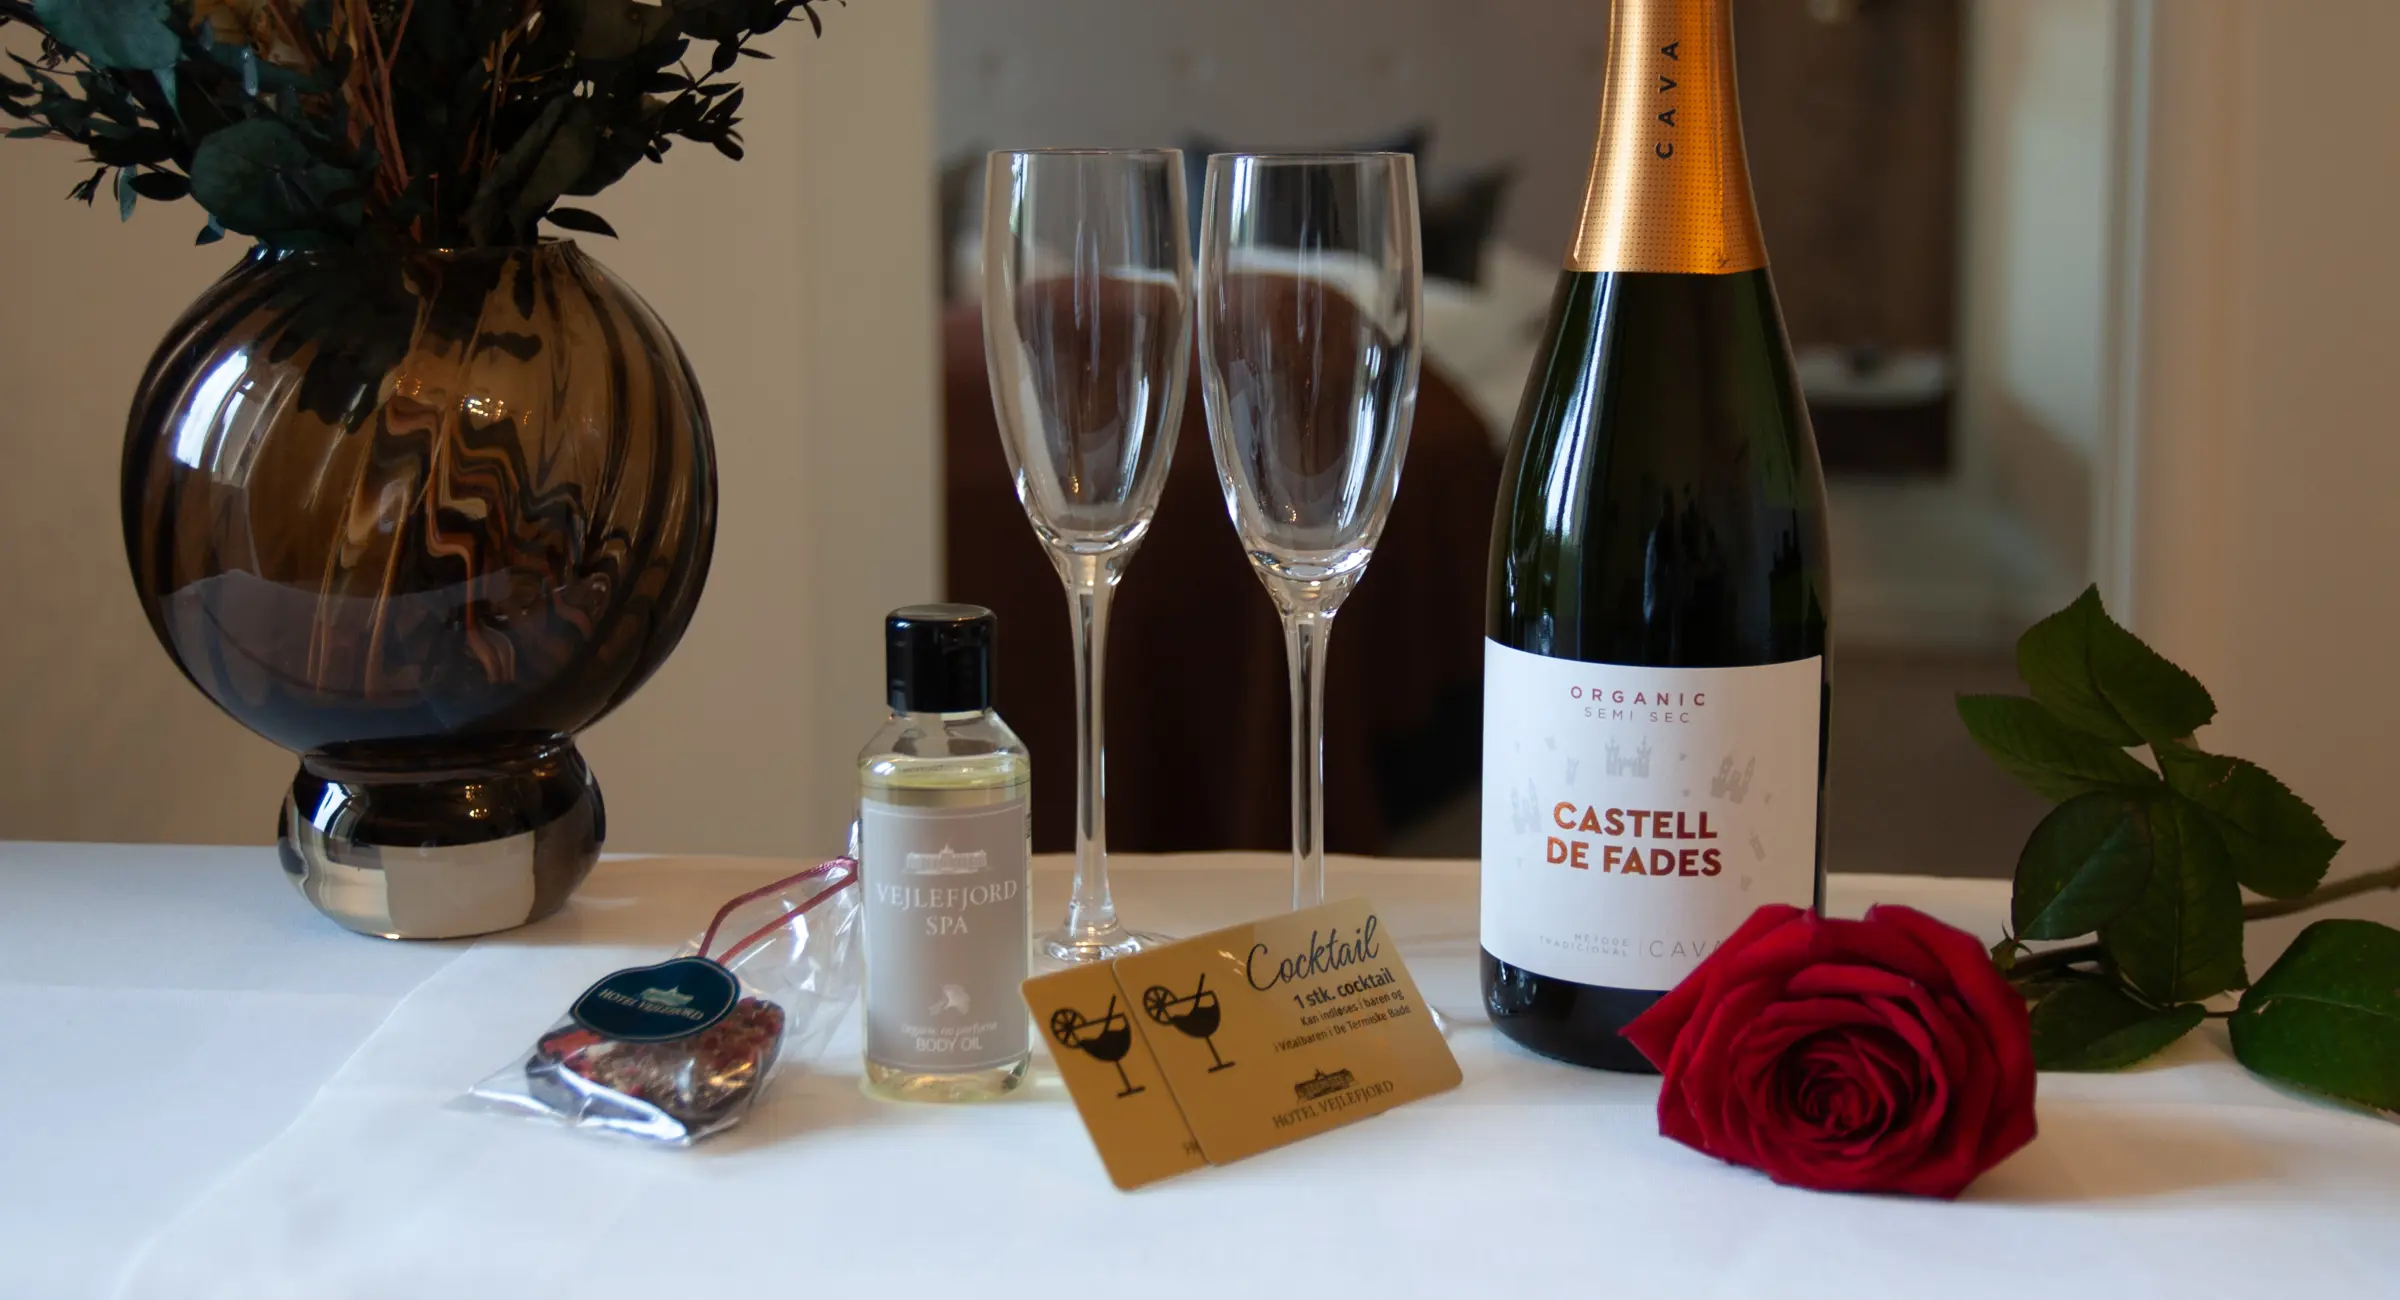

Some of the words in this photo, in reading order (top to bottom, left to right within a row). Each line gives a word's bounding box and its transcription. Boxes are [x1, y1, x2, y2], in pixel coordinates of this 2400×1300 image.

[1656, 41, 1679, 160] CAVA
[1570, 685, 1706, 706] ORGANIC
[1584, 706, 1634, 722] SEMI
[1650, 711, 1690, 723] SEC
[1553, 801, 1718, 840] CASTELL
[1546, 836, 1589, 870] DE
[1603, 845, 1722, 877] FADES
[876, 879, 1018, 911] VEJLEFJORD
[925, 916, 968, 936] SPA
[1246, 914, 1380, 992] Cocktail
[1293, 994, 1305, 1009] 1
[1305, 986, 1336, 1008] stk.
[1336, 967, 1396, 998] cocktail
[1300, 1013, 1320, 1027] Kan
[1363, 993, 1391, 1009] baren
[1391, 988, 1405, 1001] og
[1332, 1023, 1349, 1036] De
[1347, 1011, 1389, 1031] Termiske
[1387, 1004, 1412, 1019] Bade
[916, 1037, 957, 1053] BODY
[961, 1036, 983, 1052] OIL
[1272, 1106, 1319, 1129] HOTEL
[1319, 1080, 1394, 1113] VEJLEFJORD
